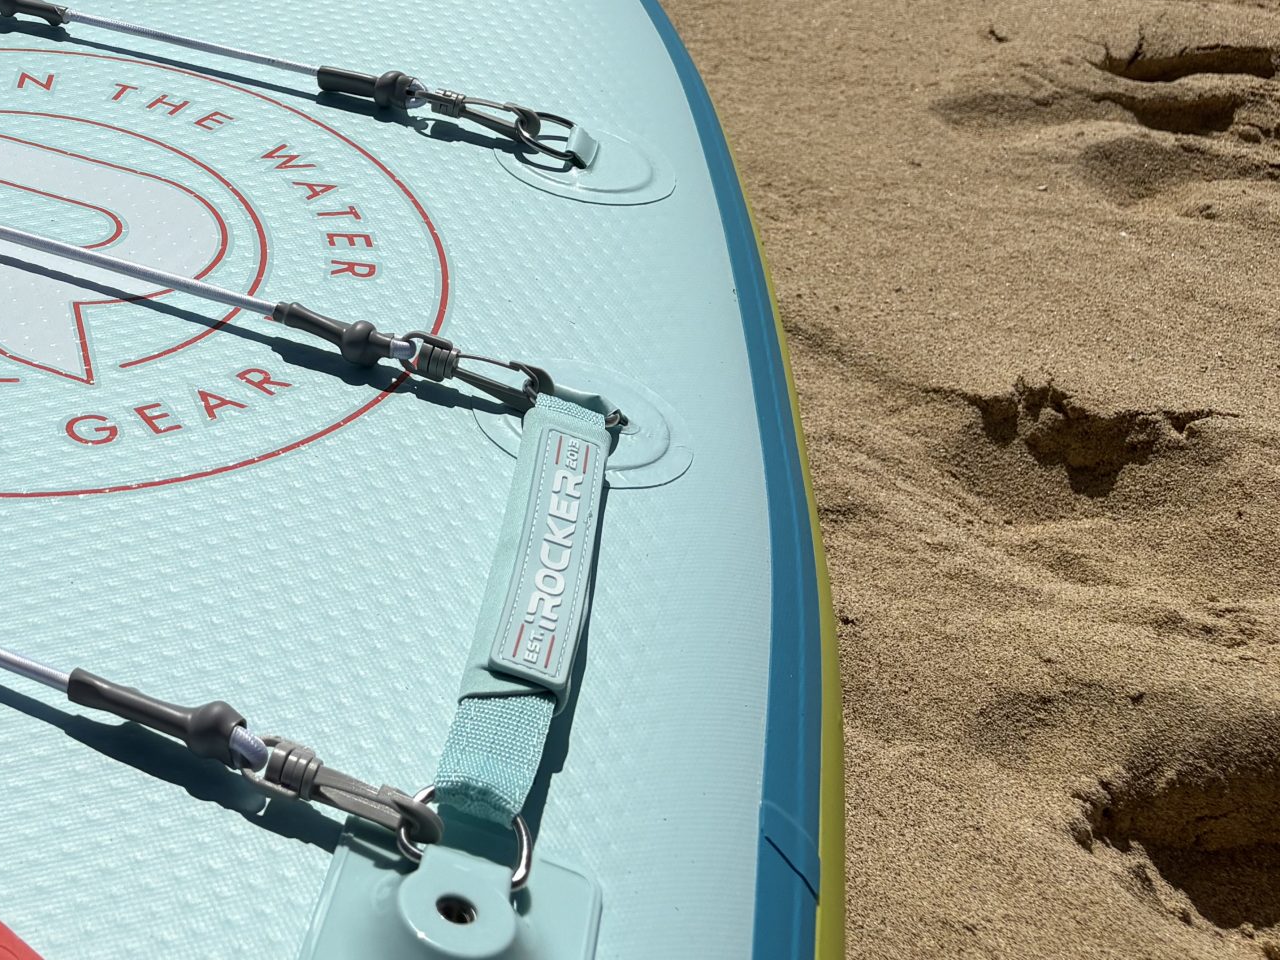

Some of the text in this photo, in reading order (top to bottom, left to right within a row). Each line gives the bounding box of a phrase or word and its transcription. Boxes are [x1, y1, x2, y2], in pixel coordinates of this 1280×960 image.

[112, 83, 232, 129] THE
[261, 144, 377, 279] WATER
[65, 368, 291, 446] GEAR
[565, 440, 581, 471] 2013
